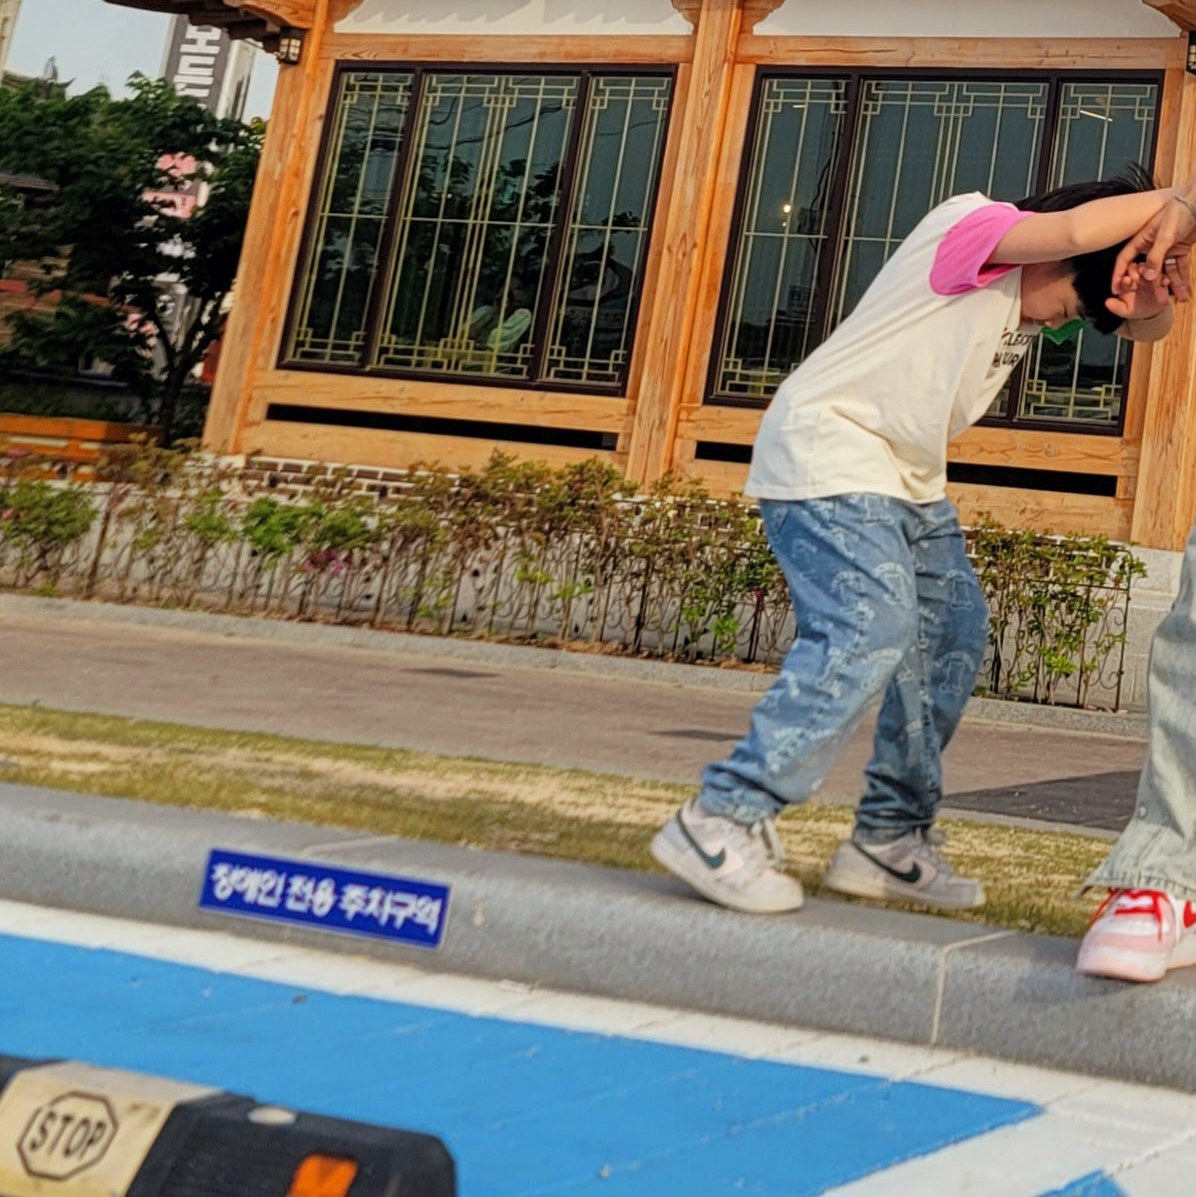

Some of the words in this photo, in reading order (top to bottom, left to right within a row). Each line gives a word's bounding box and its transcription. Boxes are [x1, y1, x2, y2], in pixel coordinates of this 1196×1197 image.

[211, 862, 287, 908] 장애인
[286, 874, 337, 917] 전용
[338, 883, 442, 935] 주차구역
[30, 1112, 107, 1159] STOP
